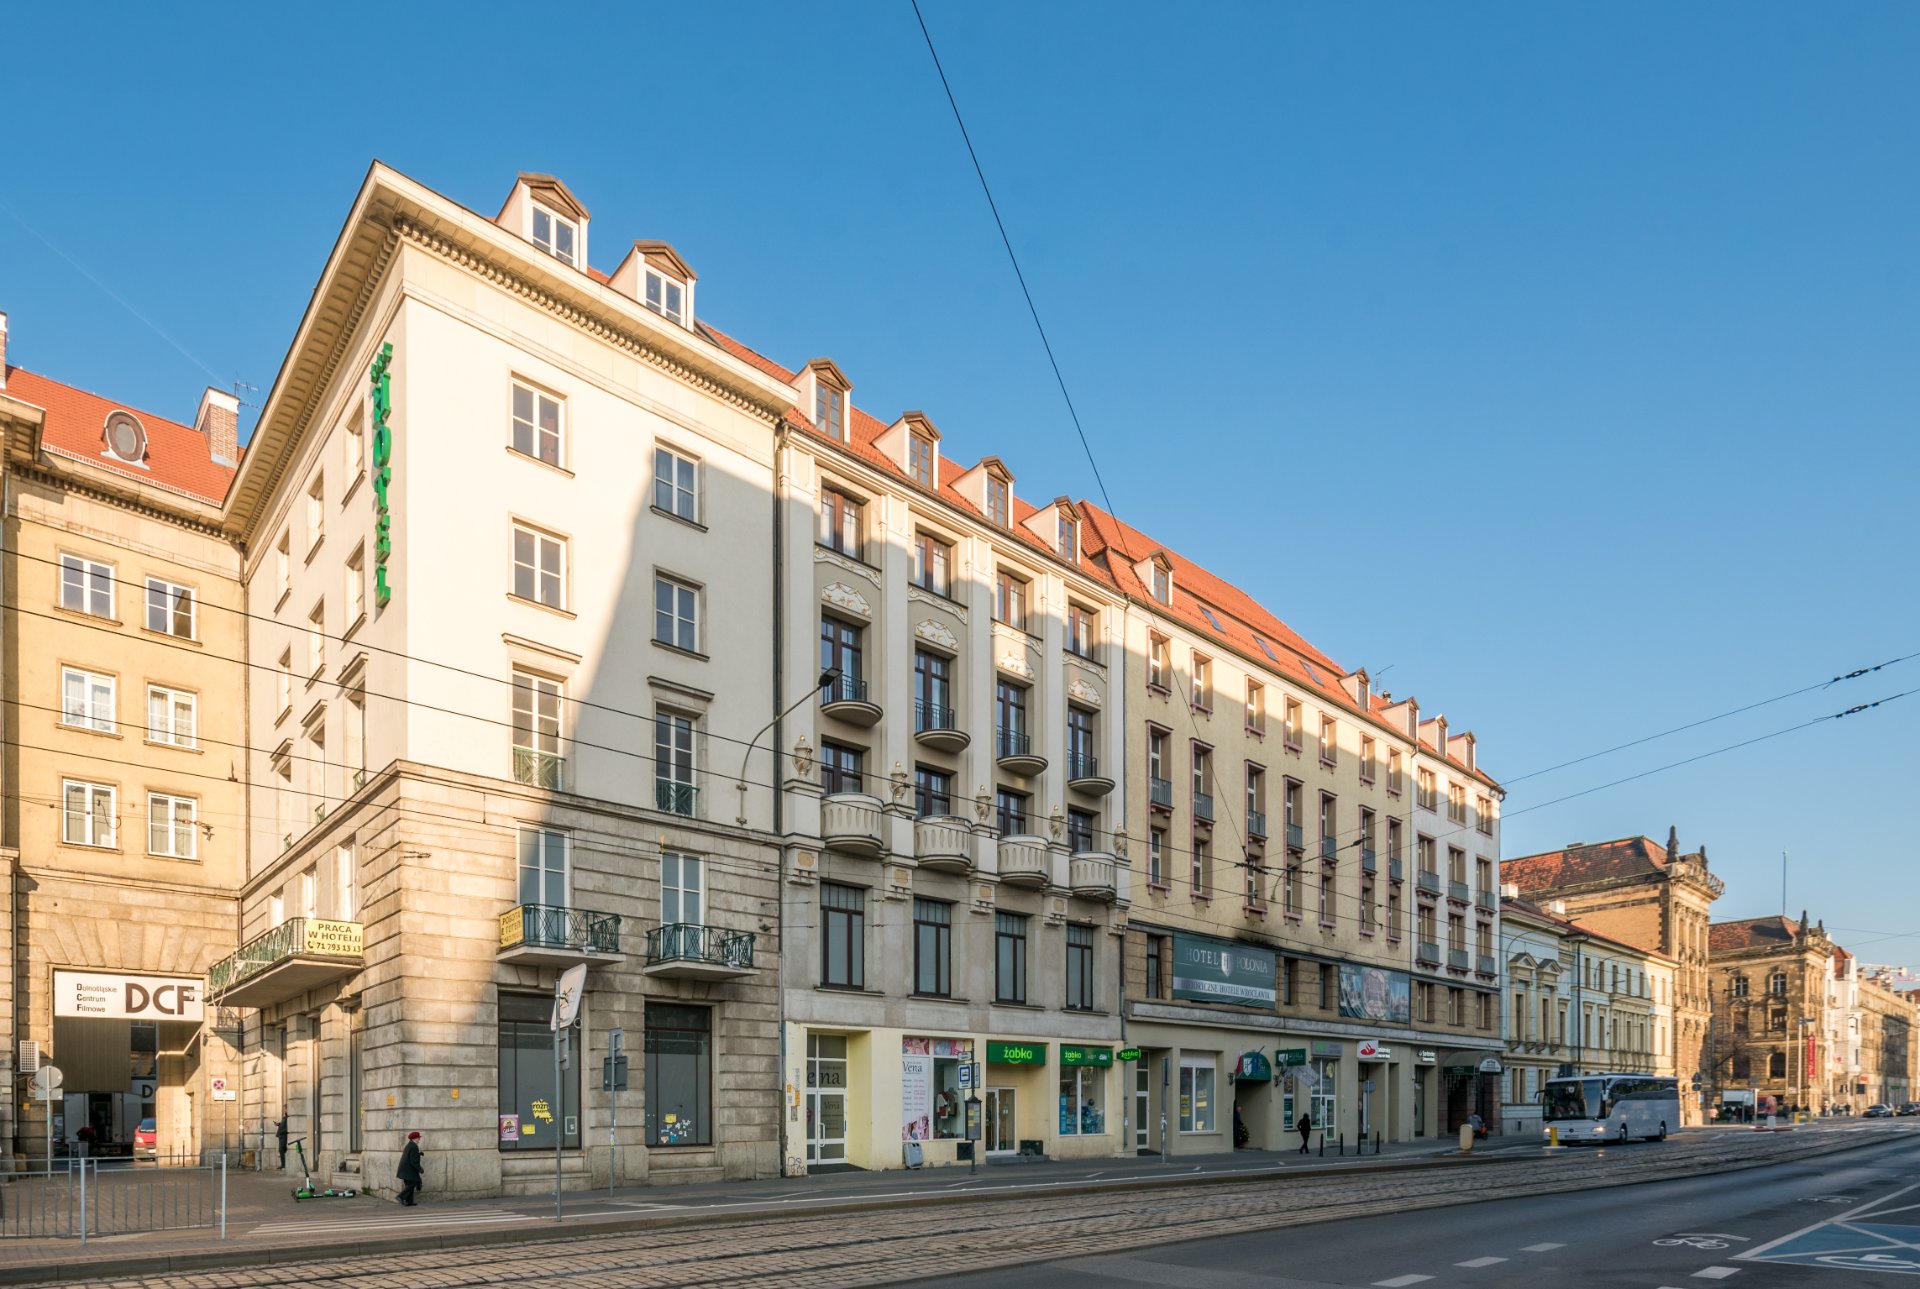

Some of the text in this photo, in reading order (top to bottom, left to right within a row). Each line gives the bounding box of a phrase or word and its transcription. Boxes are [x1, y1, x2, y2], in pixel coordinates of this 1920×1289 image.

[372, 370, 391, 609] HOTEL
[318, 923, 352, 933] PRACA
[321, 932, 361, 942] HOTELU
[327, 943, 340, 951] 793
[1186, 948, 1268, 973] HOTEL POLONIA
[76, 983, 118, 993] Dolnośląskie
[1219, 984, 1240, 995] HOTELE
[76, 993, 106, 1002] Centrum
[125, 983, 195, 1015] DCF
[76, 1004, 106, 1012] Filmowe
[1003, 1046, 1032, 1059] żabka
[1065, 1050, 1082, 1058] żabka
[902, 1061, 923, 1072] Vena
[807, 1070, 841, 1085] ena
